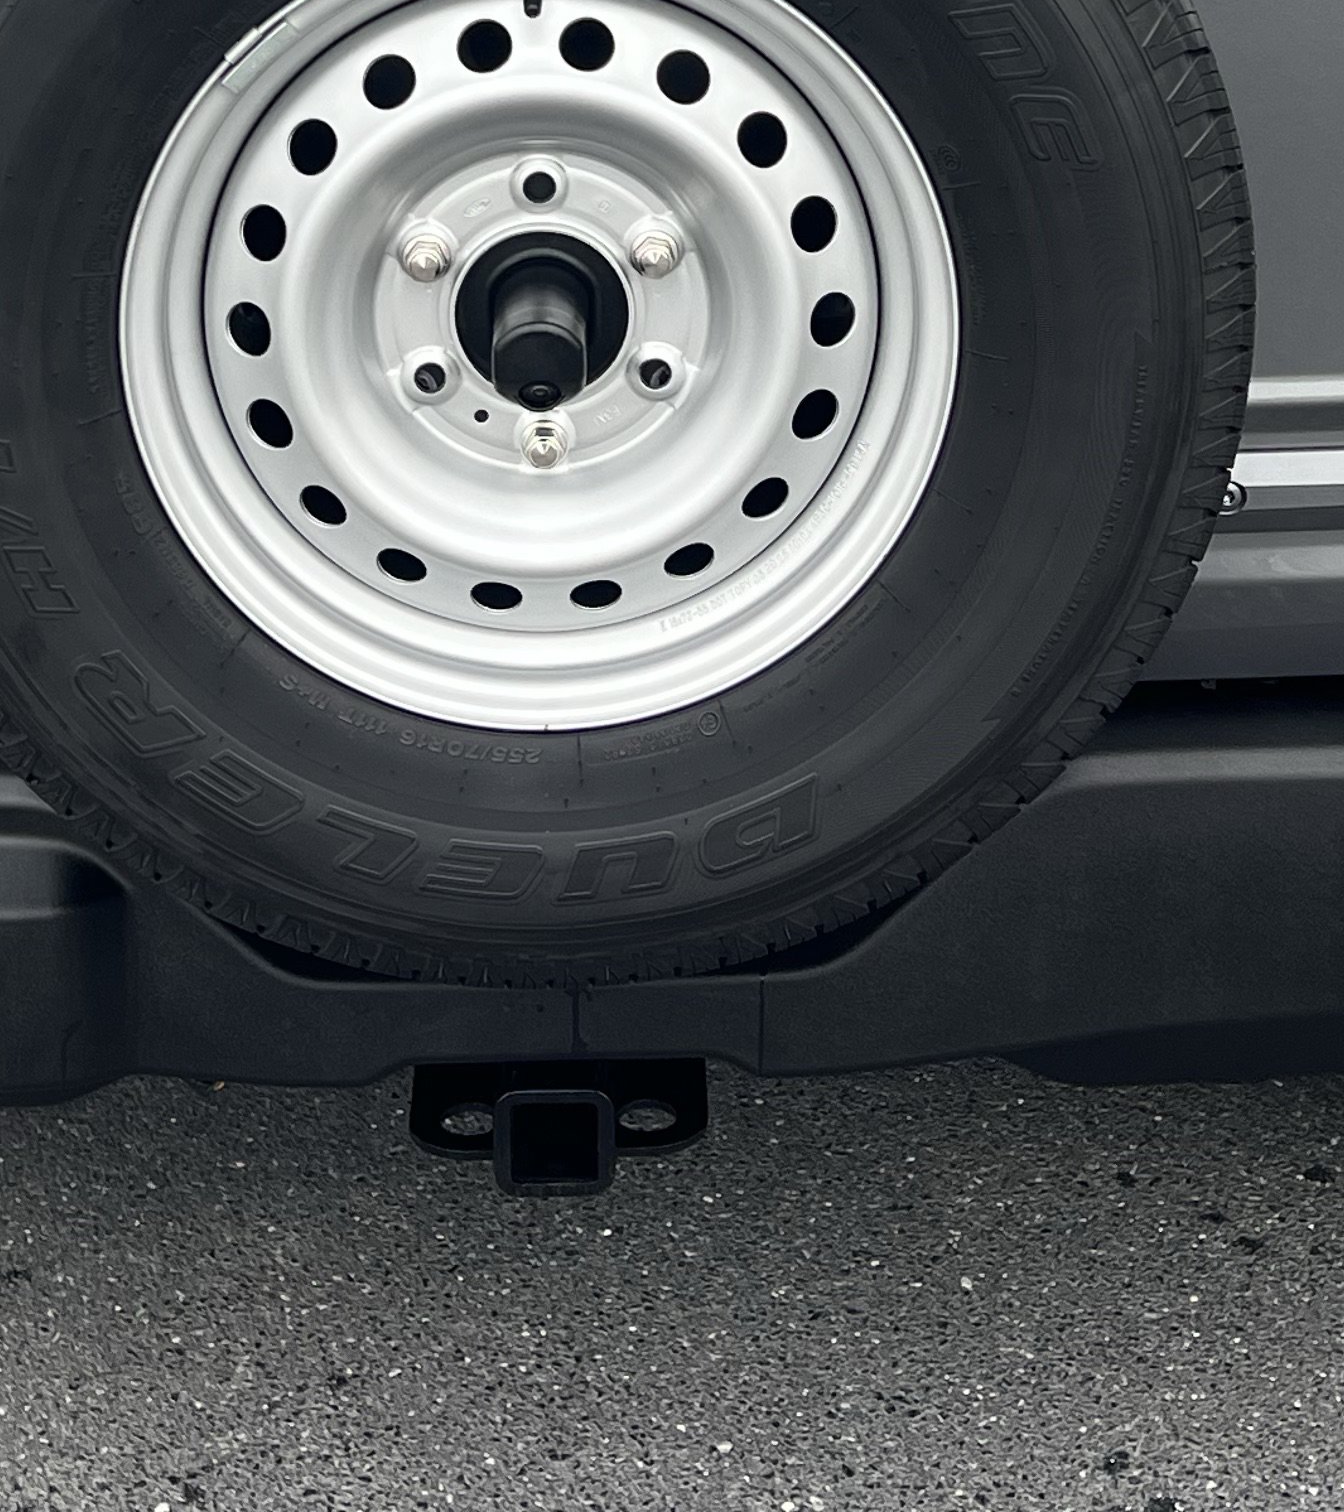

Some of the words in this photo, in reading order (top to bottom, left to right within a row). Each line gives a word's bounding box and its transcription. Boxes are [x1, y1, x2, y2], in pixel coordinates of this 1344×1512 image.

[279, 671, 332, 712] M+S
[397, 727, 541, 764] 255/70R16
[74, 648, 819, 905] DUELER
